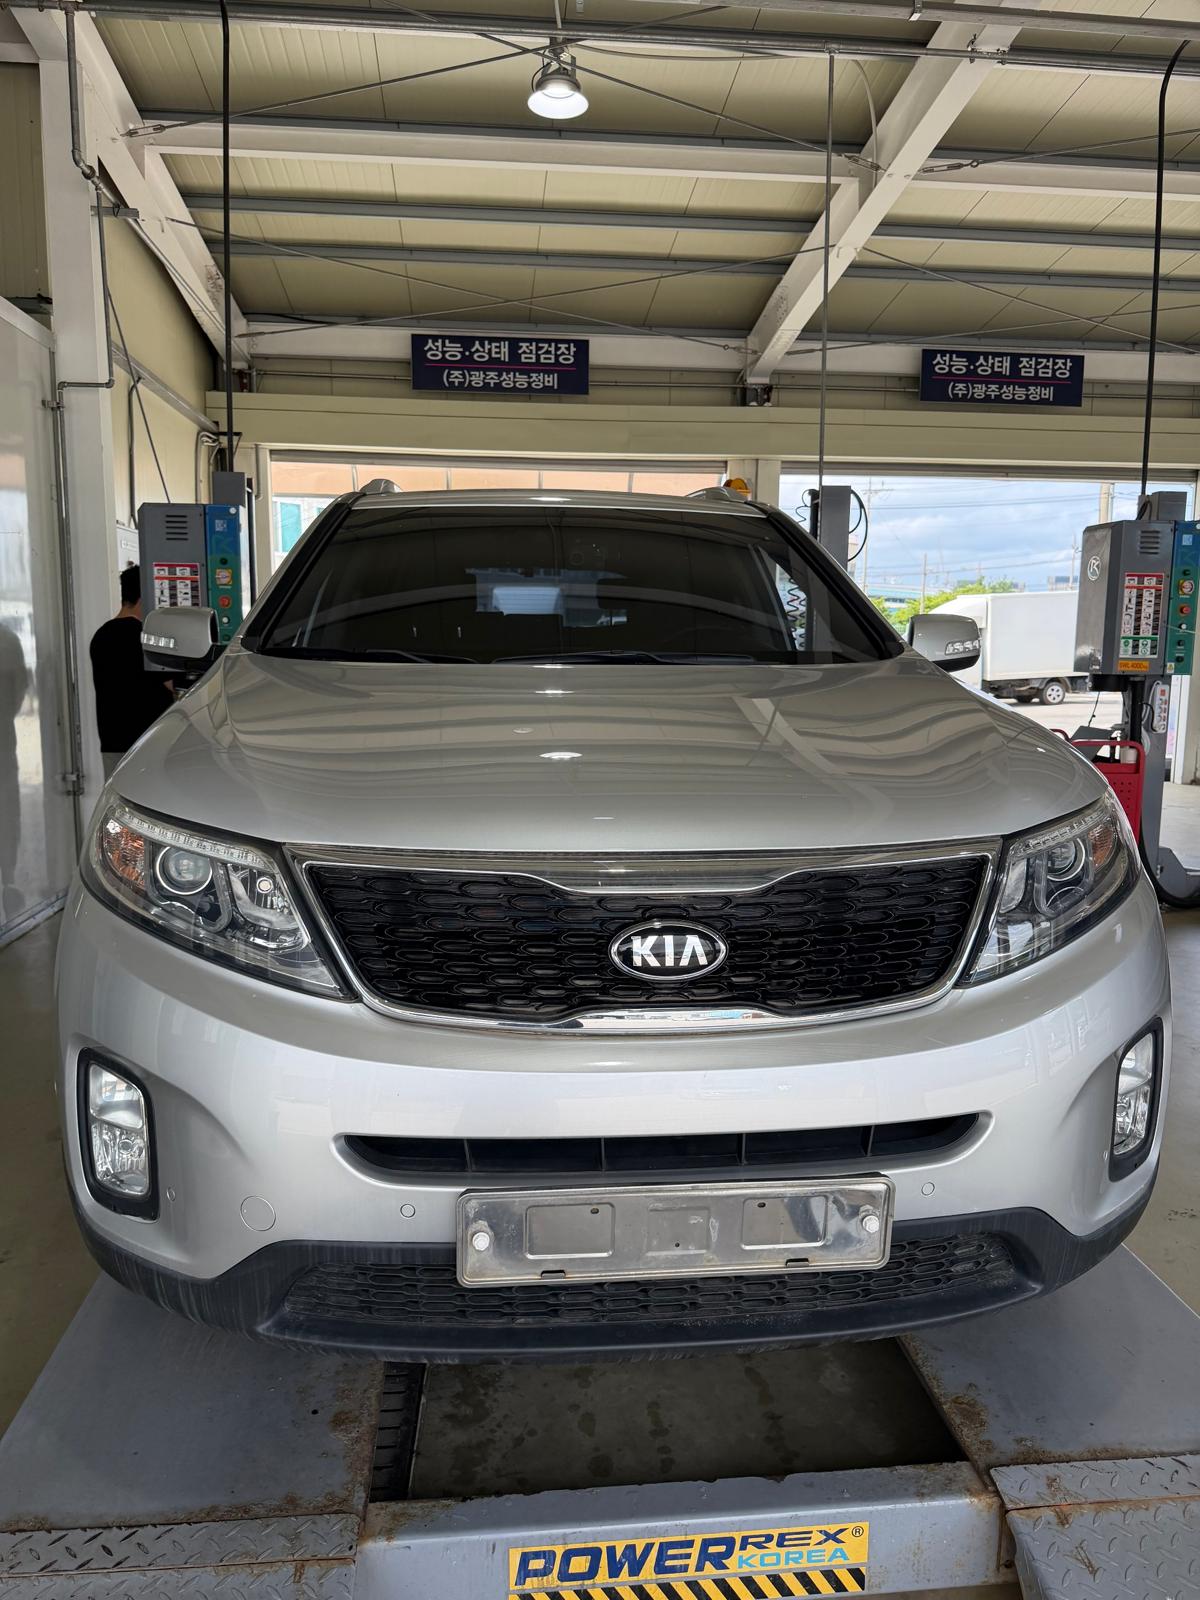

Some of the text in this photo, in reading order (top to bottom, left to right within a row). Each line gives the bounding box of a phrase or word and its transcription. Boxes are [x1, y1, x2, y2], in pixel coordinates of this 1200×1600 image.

[518, 342, 576, 364] 점검장
[1018, 356, 1072, 378] 점검장
[443, 369, 558, 389] (주)광주성능정비
[948, 382, 1054, 401] (주)광주성능정비
[631, 935, 708, 967] KIA
[737, 1547, 850, 1569] KOREA
